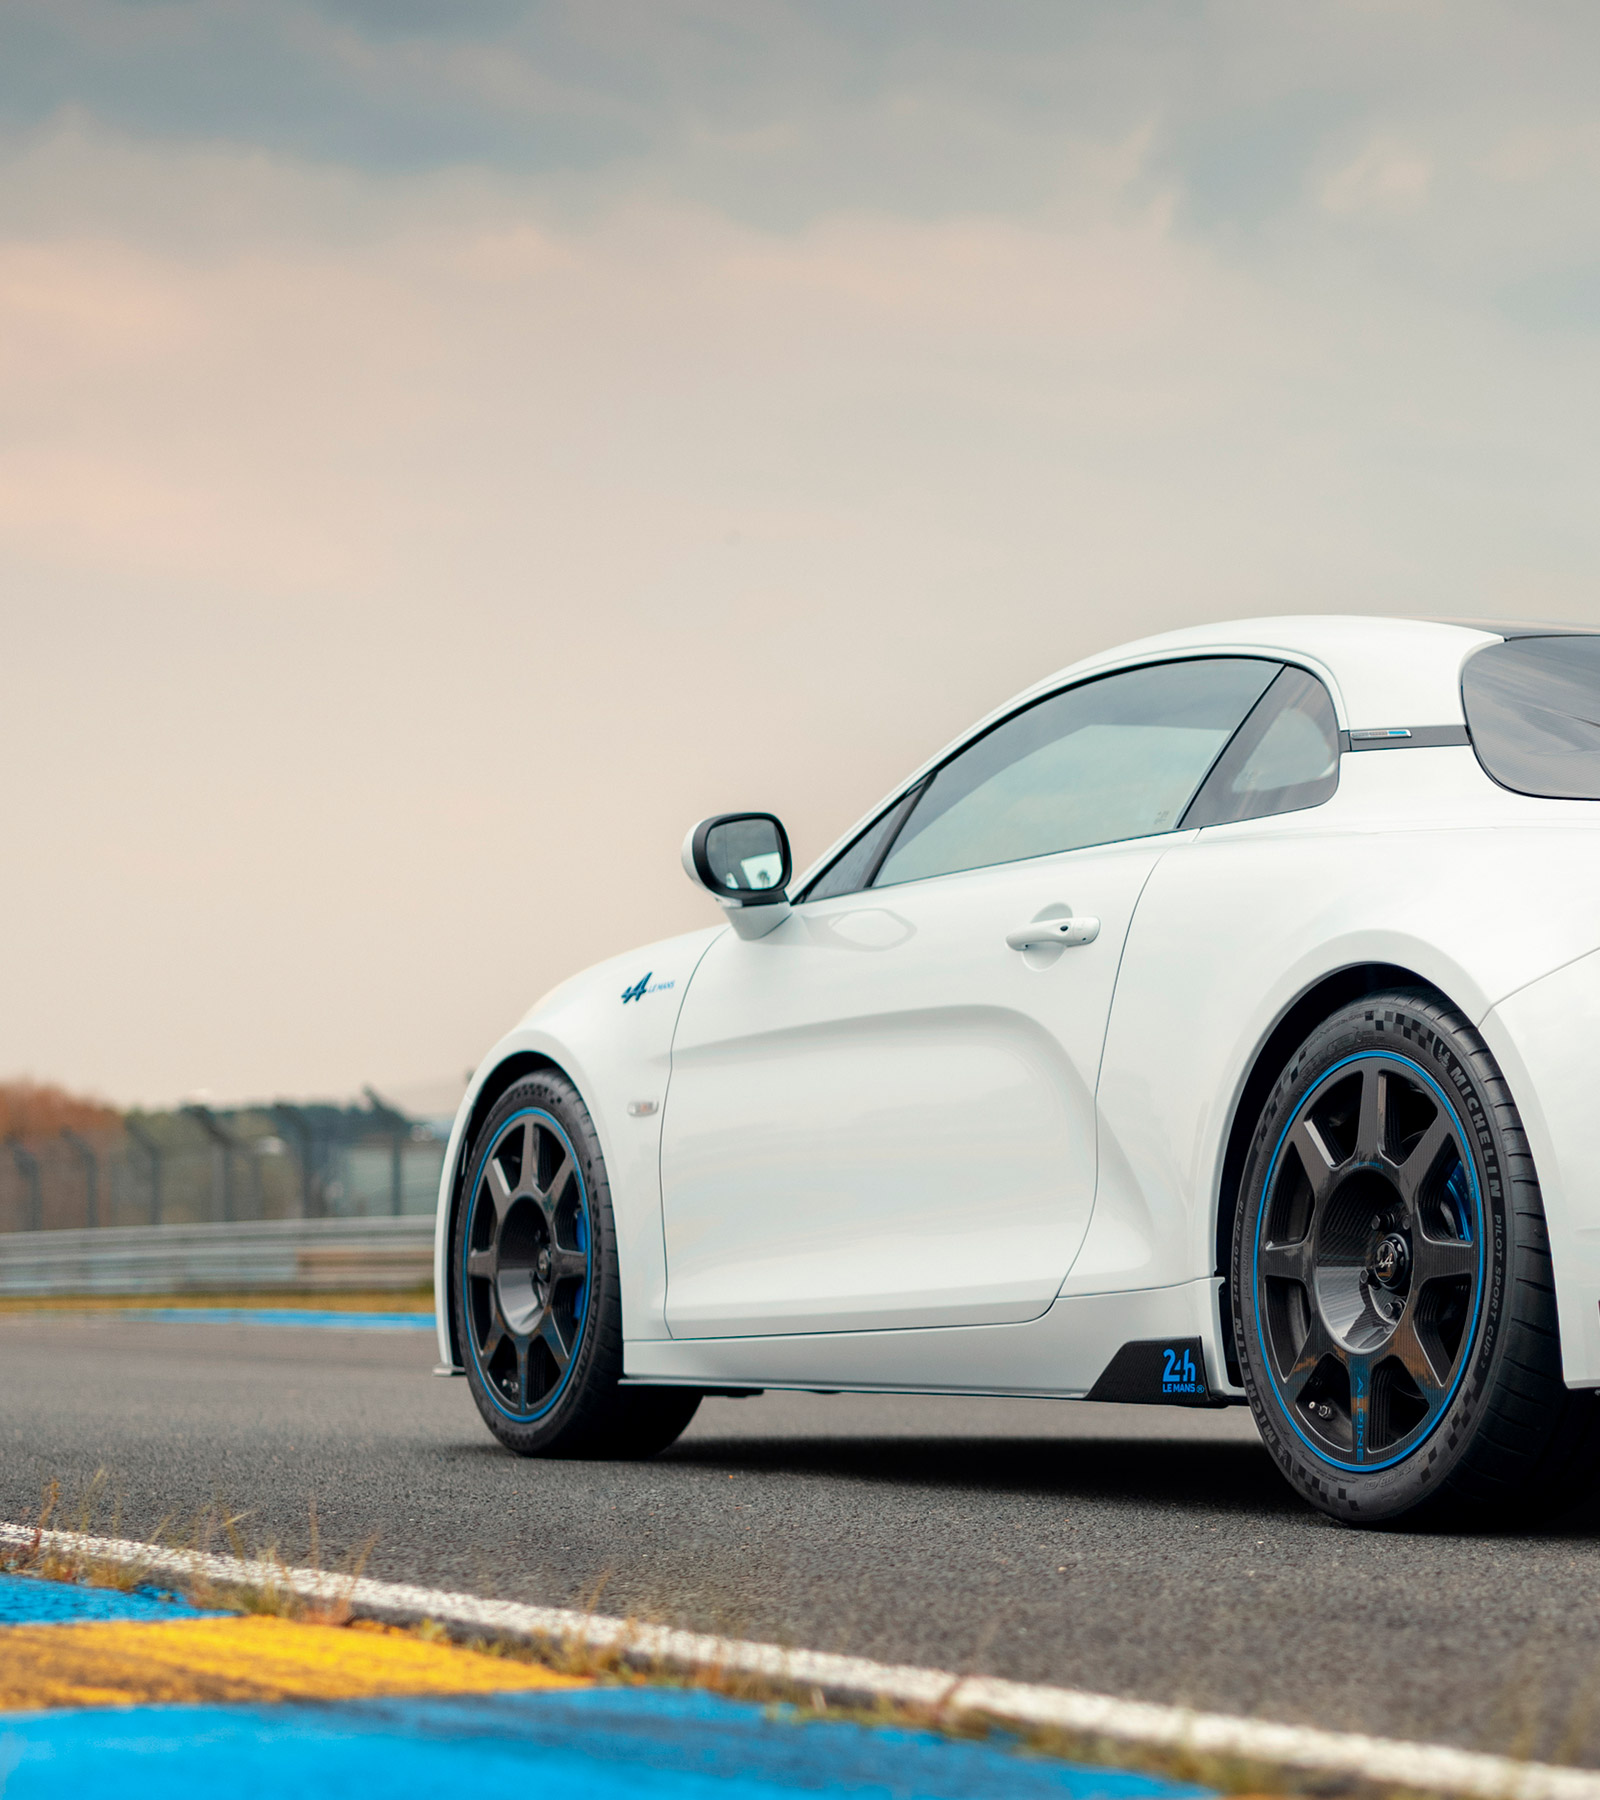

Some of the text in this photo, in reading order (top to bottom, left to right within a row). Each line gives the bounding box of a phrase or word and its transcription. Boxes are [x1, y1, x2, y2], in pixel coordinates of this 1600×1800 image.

[1450, 1066, 1502, 1198] MICHELIN
[1494, 1214, 1503, 1259] PILOT
[1489, 1266, 1502, 1321] SPORT
[1483, 1327, 1495, 1357] CUP
[1162, 1383, 1196, 1393] LE MANS
[1234, 1317, 1277, 1444] MICHELIN
